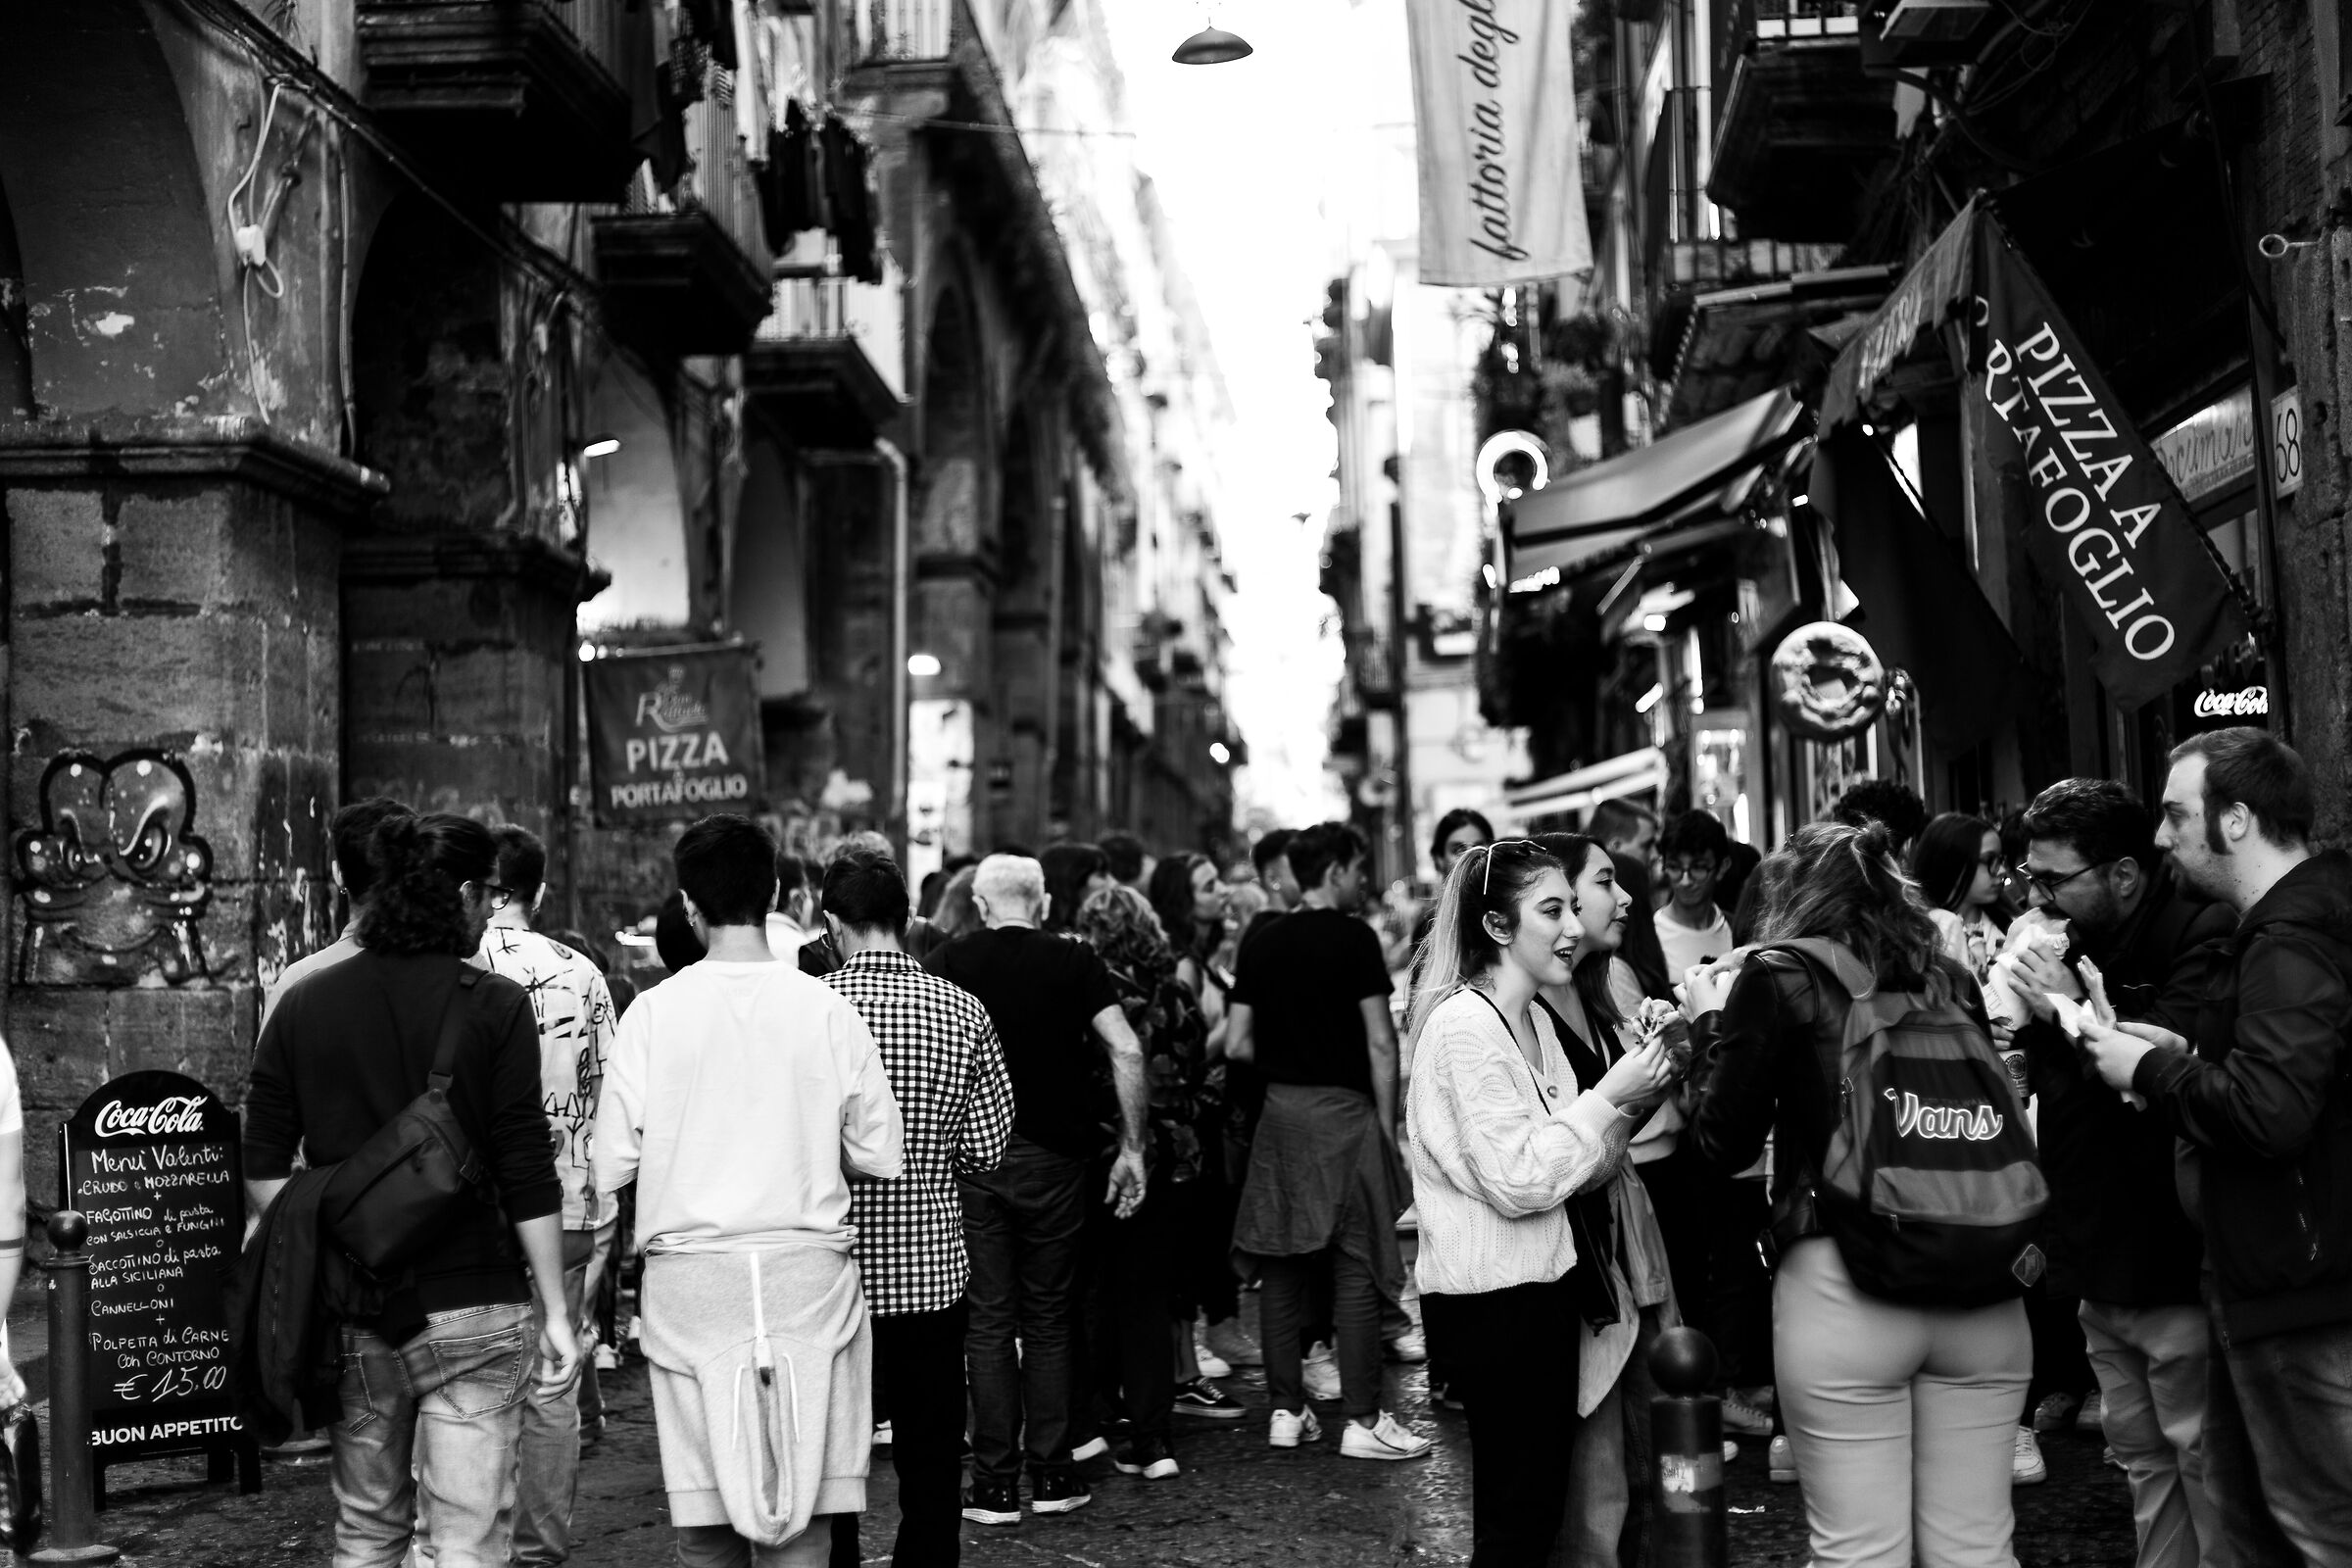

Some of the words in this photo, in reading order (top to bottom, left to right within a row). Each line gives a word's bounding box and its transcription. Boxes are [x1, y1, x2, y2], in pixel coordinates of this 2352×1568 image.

[1468, 100, 1530, 261] fattoria
[2013, 321, 2133, 502] PIZZA
[2110, 503, 2162, 549] A
[2276, 407, 2301, 484] 68
[1975, 296, 2175, 661] RTAFOGLIO
[625, 731, 729, 773] PIZZA
[611, 773, 748, 808] PORTAFOGLIO
[94, 1095, 209, 1138] Coca-Cola
[1884, 1088, 2003, 1141] Vans
[144, 1170, 230, 1190] MOZZARELLA
[86, 1205, 153, 1225] FAGOTTINO
[110, 1225, 162, 1243] SALSICCIA
[164, 1247, 180, 1264] di
[182, 1243, 221, 1265] pasta
[90, 1276, 119, 1291] ALLA
[122, 1266, 184, 1284] SICILIANA
[90, 1298, 174, 1317] CANNELLONI
[163, 1328, 177, 1345] di
